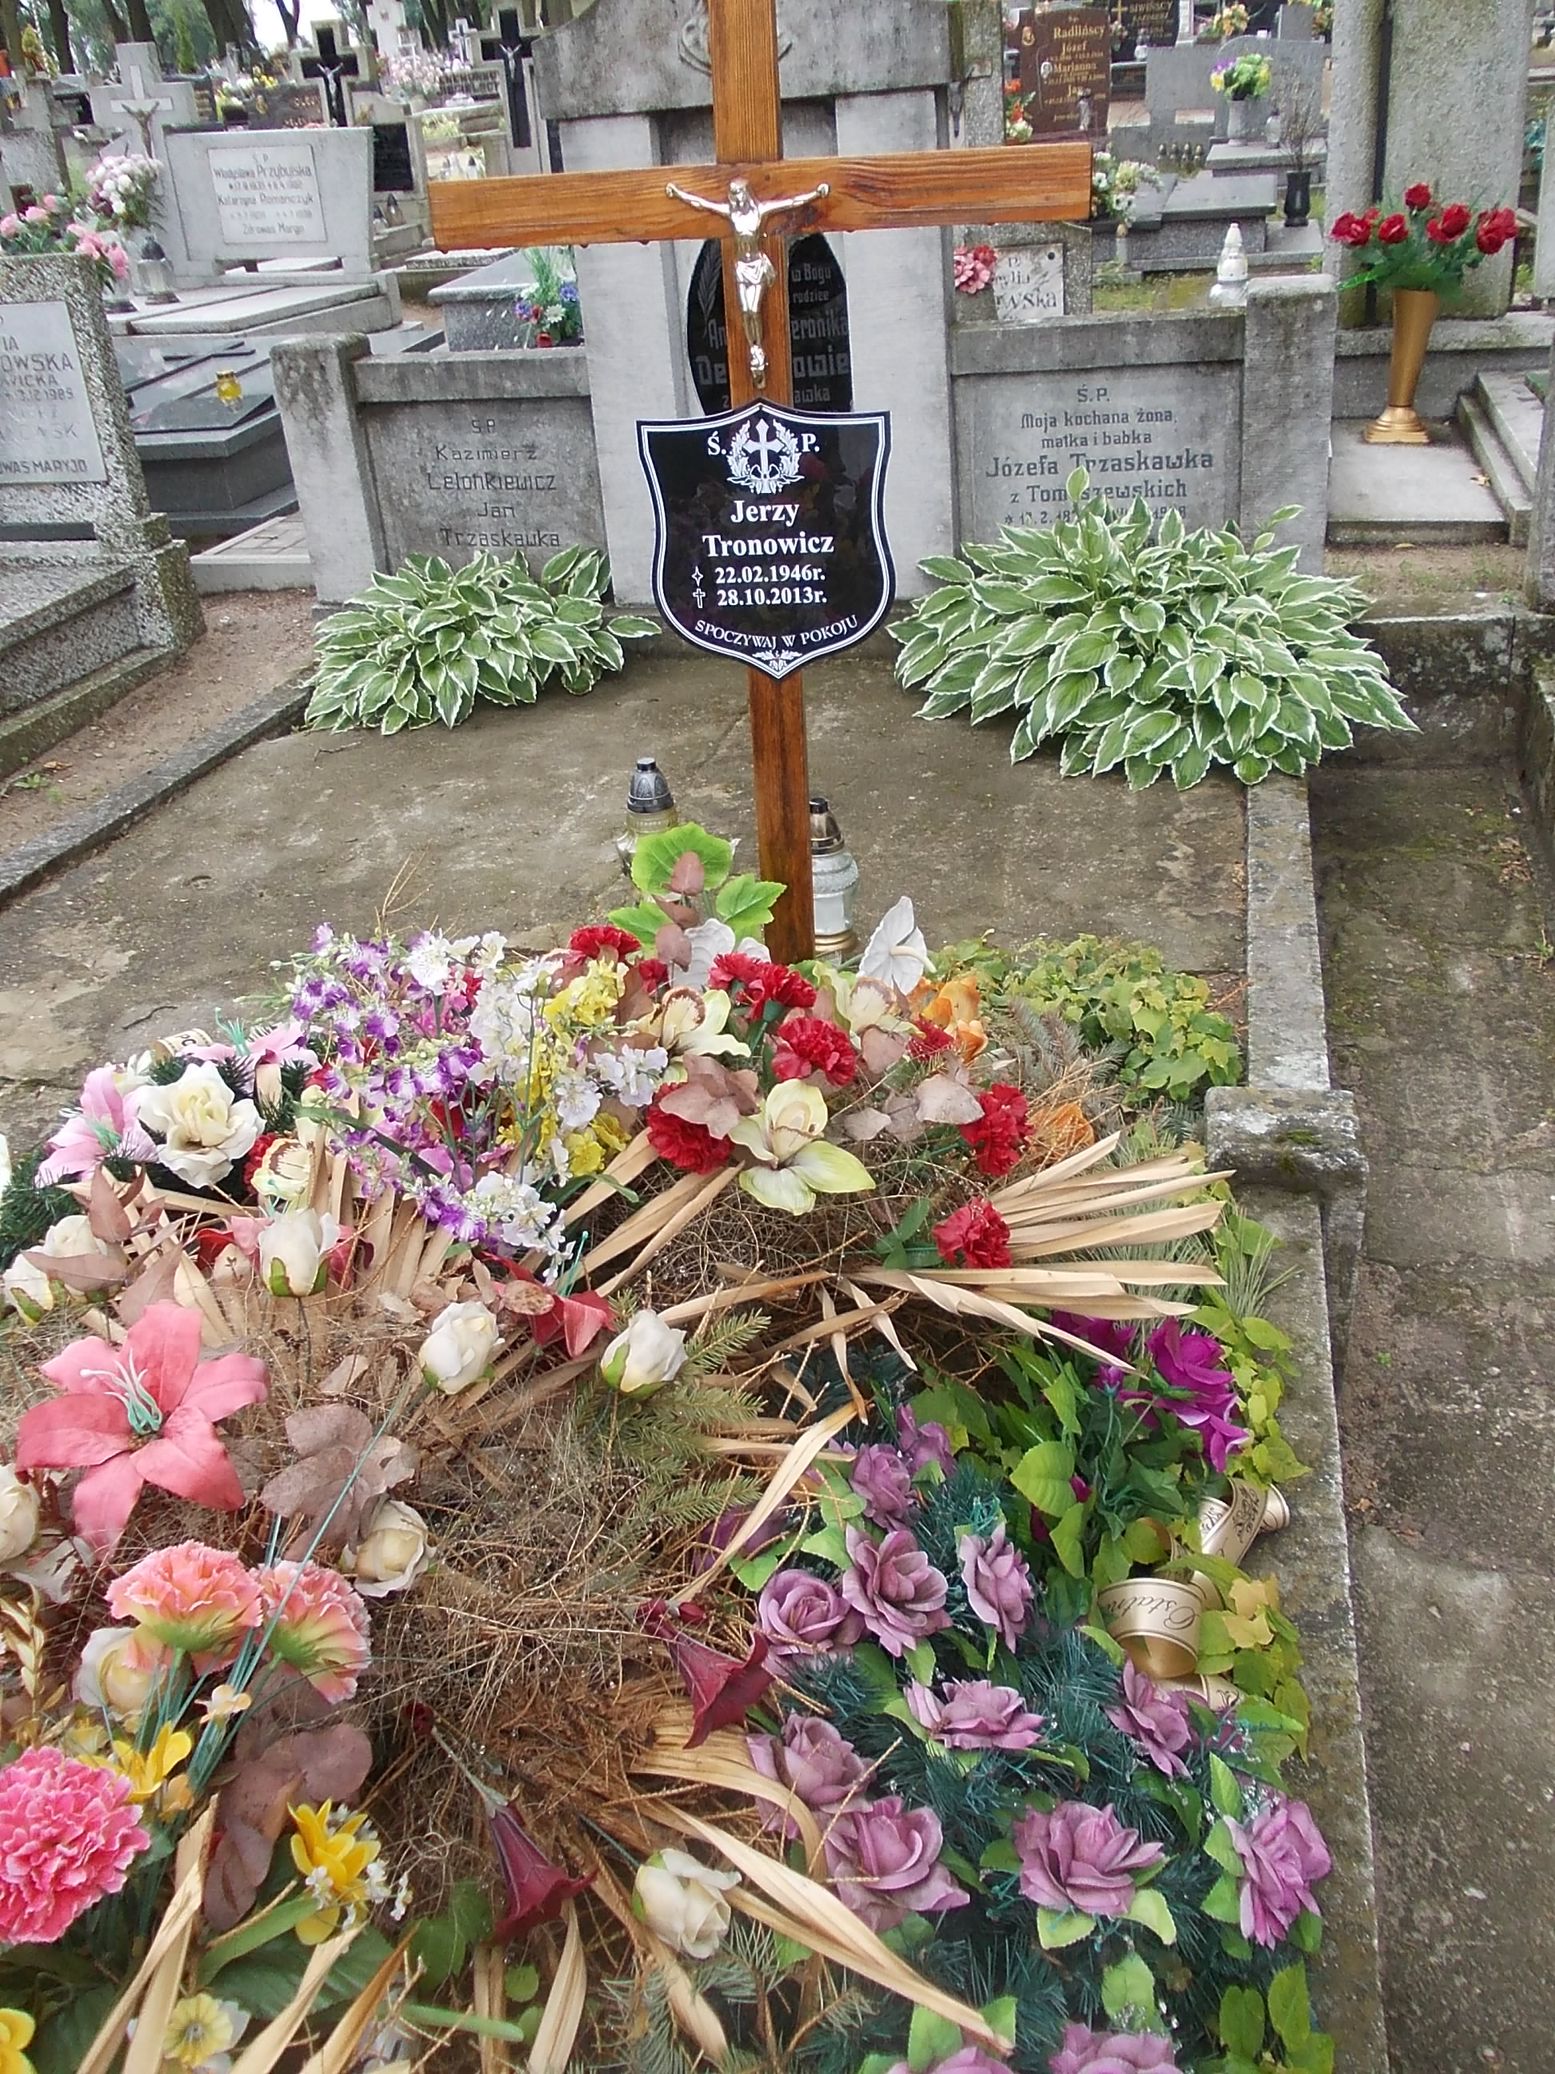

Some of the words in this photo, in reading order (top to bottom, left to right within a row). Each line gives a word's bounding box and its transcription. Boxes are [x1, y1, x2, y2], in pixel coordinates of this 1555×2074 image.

[1021, 411, 1057, 433] Moja
[1064, 409, 1129, 427] kochana
[707, 431, 727, 455] Ś.
[802, 433, 820, 452] P.
[1042, 433, 1088, 449] matka
[1103, 430, 1152, 445] babka
[32, 458, 88, 473] MARYJO
[986, 455, 1058, 478] Józefa
[1070, 448, 1214, 473] Trzaskawka
[1026, 478, 1187, 502] Tomszewskich
[477, 502, 516, 518] Jan
[730, 500, 800, 527] Jerzy
[440, 528, 560, 547] Trzaskawka
[702, 531, 834, 557] Tronowicz
[715, 564, 826, 584] 22.02.1946r.
[716, 586, 828, 607] 28.10.2013r.
[694, 620, 777, 649] SPOCZYWAJ
[781, 635, 797, 648] W
[800, 614, 859, 645] POKOJU
